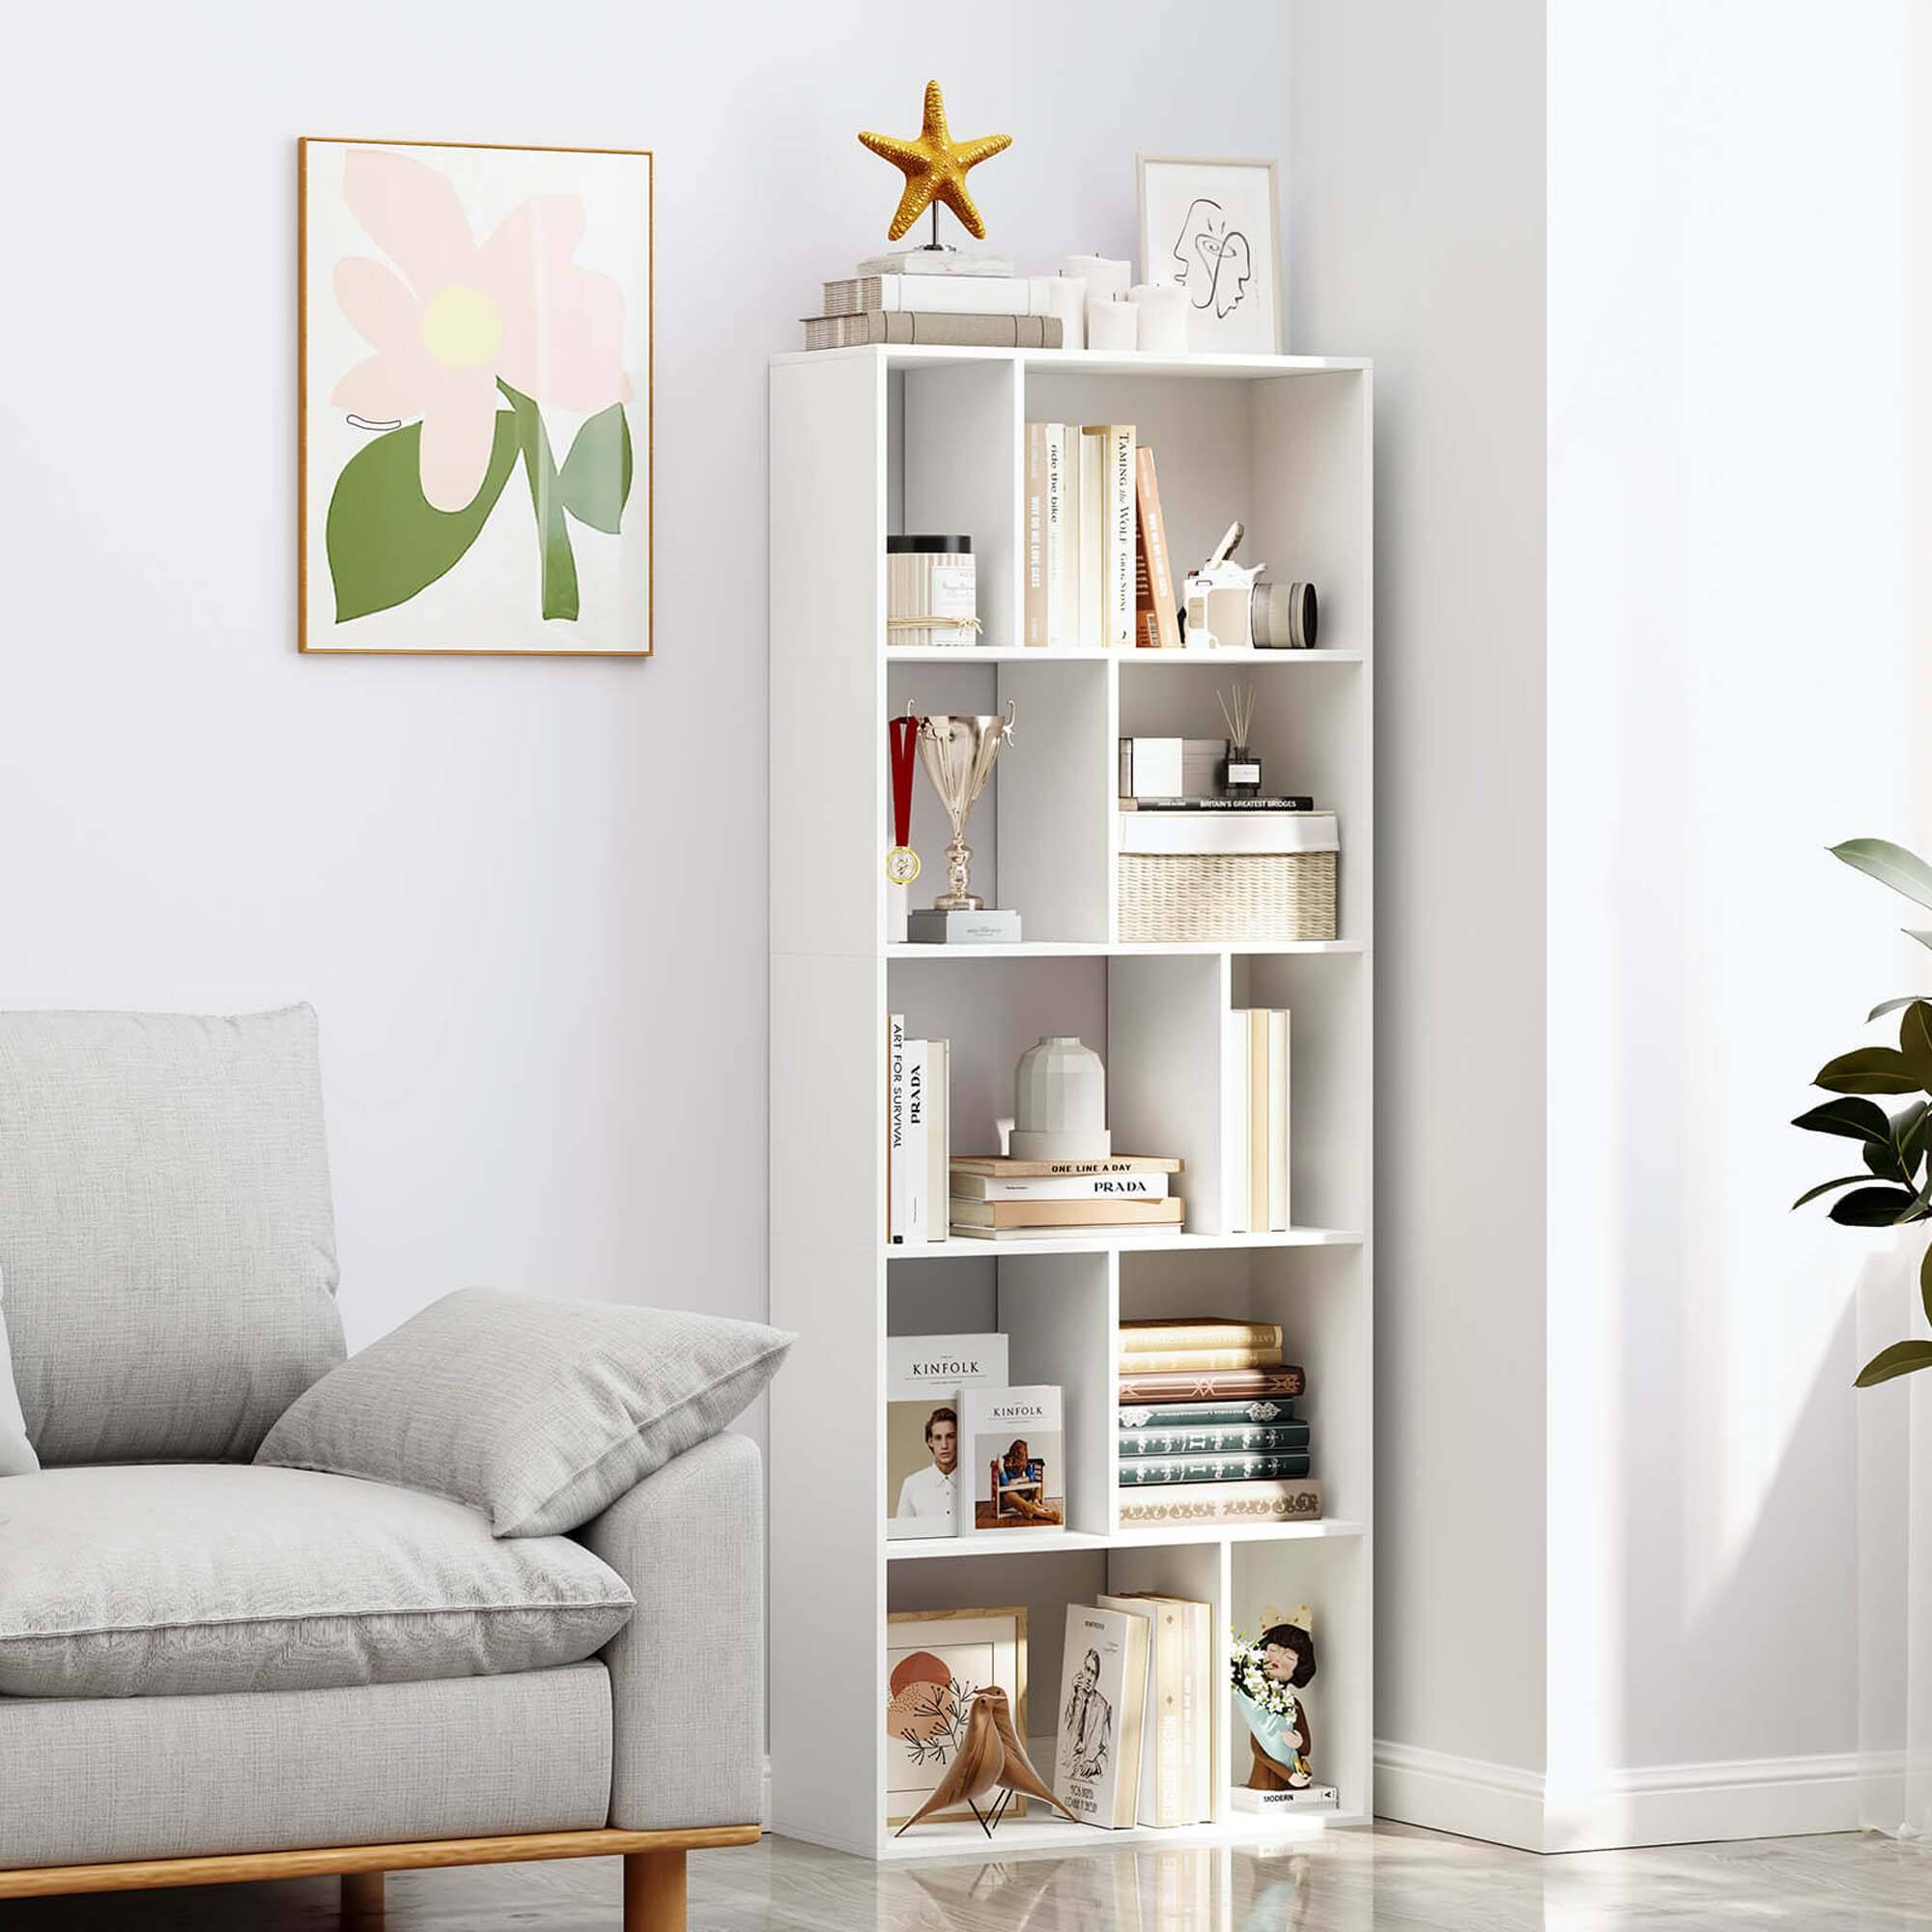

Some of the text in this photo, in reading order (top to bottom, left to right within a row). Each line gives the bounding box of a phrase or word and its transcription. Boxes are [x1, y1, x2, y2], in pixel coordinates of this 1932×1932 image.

[1119, 432, 1130, 487] TAMING
[1119, 506, 1130, 544] WOLF
[1200, 800, 1232, 809] BRITAIN'S
[893, 1023, 902, 1149] ART FOR SURVIVAL
[910, 1065, 921, 1124] PRADA
[1051, 1164, 1072, 1173] ONE
[1076, 1164, 1098, 1173] LINE
[1094, 1180, 1148, 1193] PRADA
[913, 1361, 980, 1376] KINFOLK
[993, 1406, 1043, 1417] KINFOLK
[1264, 1794, 1294, 1803] MODERN
